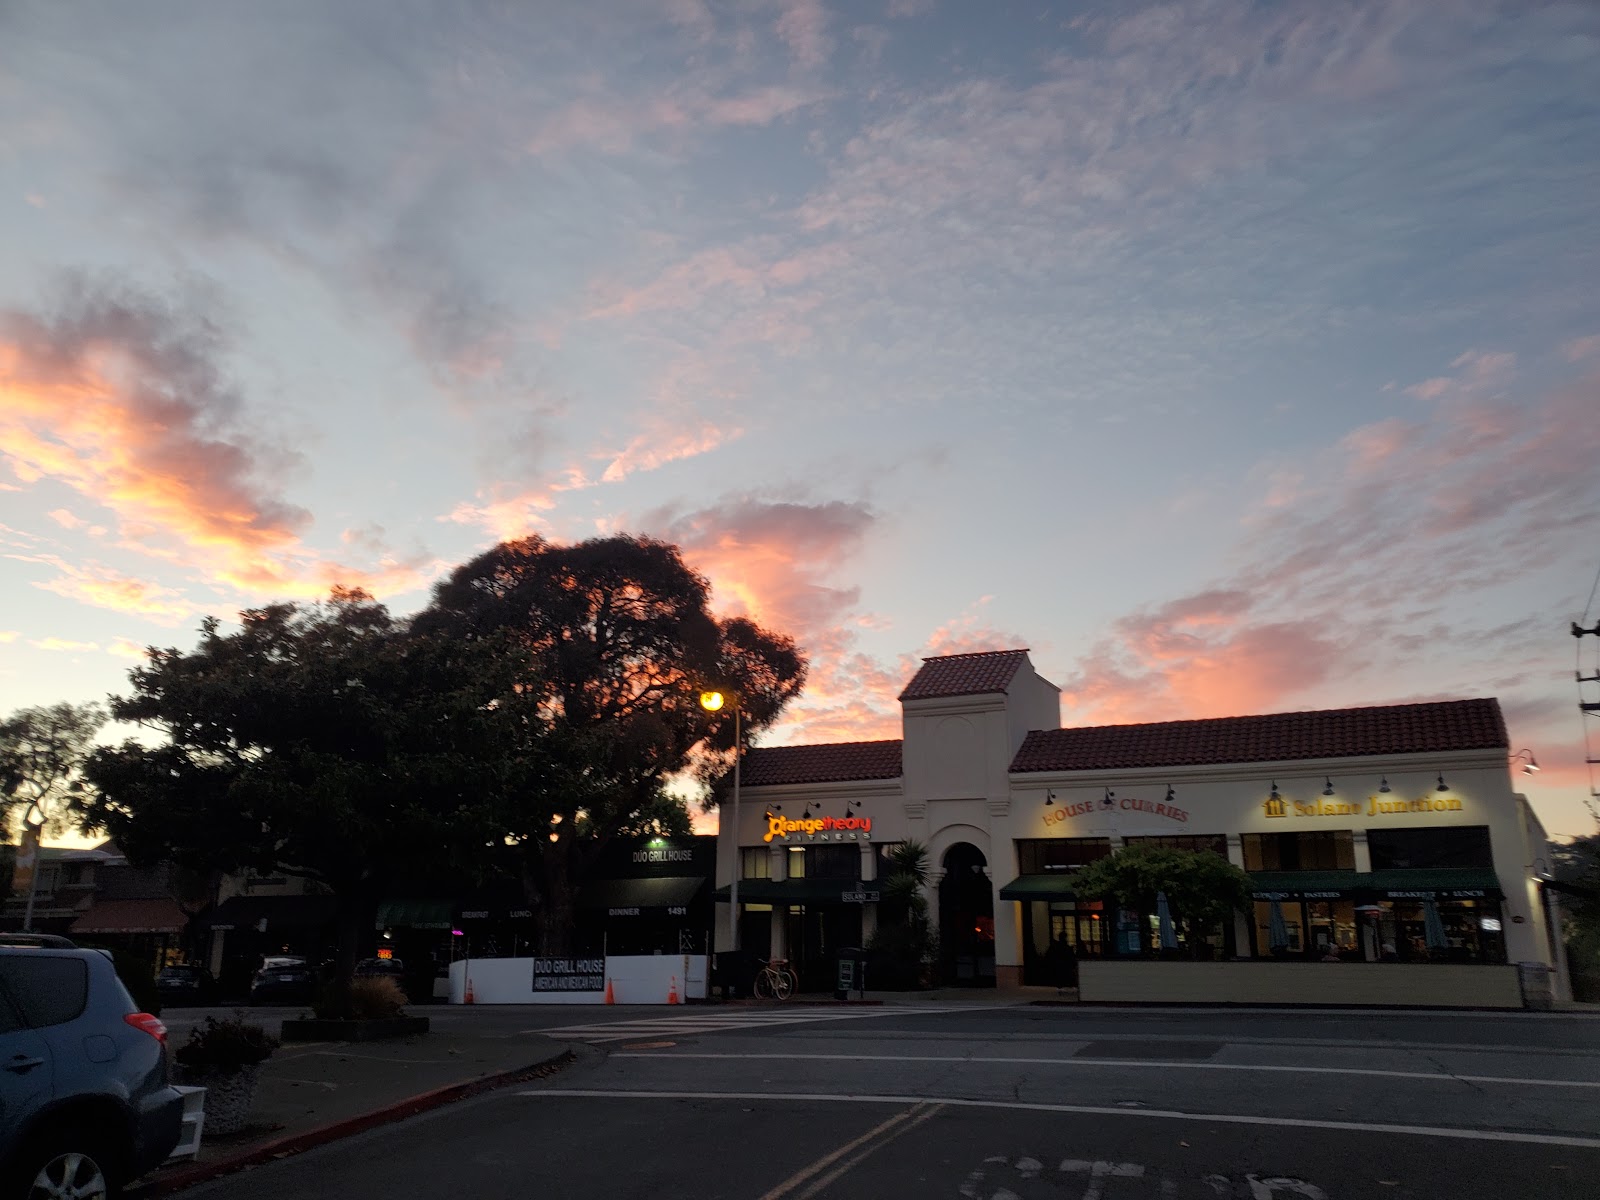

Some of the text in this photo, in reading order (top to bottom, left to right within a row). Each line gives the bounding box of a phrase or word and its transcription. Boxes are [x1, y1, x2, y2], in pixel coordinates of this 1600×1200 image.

[1042, 801, 1093, 827] HOUSE
[1120, 799, 1189, 822] CURRIES
[1294, 795, 1463, 817] Solano Junction
[784, 833, 871, 841] FITNESS
[632, 849, 693, 863] DUO GRILL HOUSE
[509, 910, 532, 918] LUNC
[608, 907, 640, 916] DINNER
[667, 906, 687, 915] 1491
[535, 959, 604, 974] DUO GRILL HOUSE
[589, 976, 603, 989] FOOD
